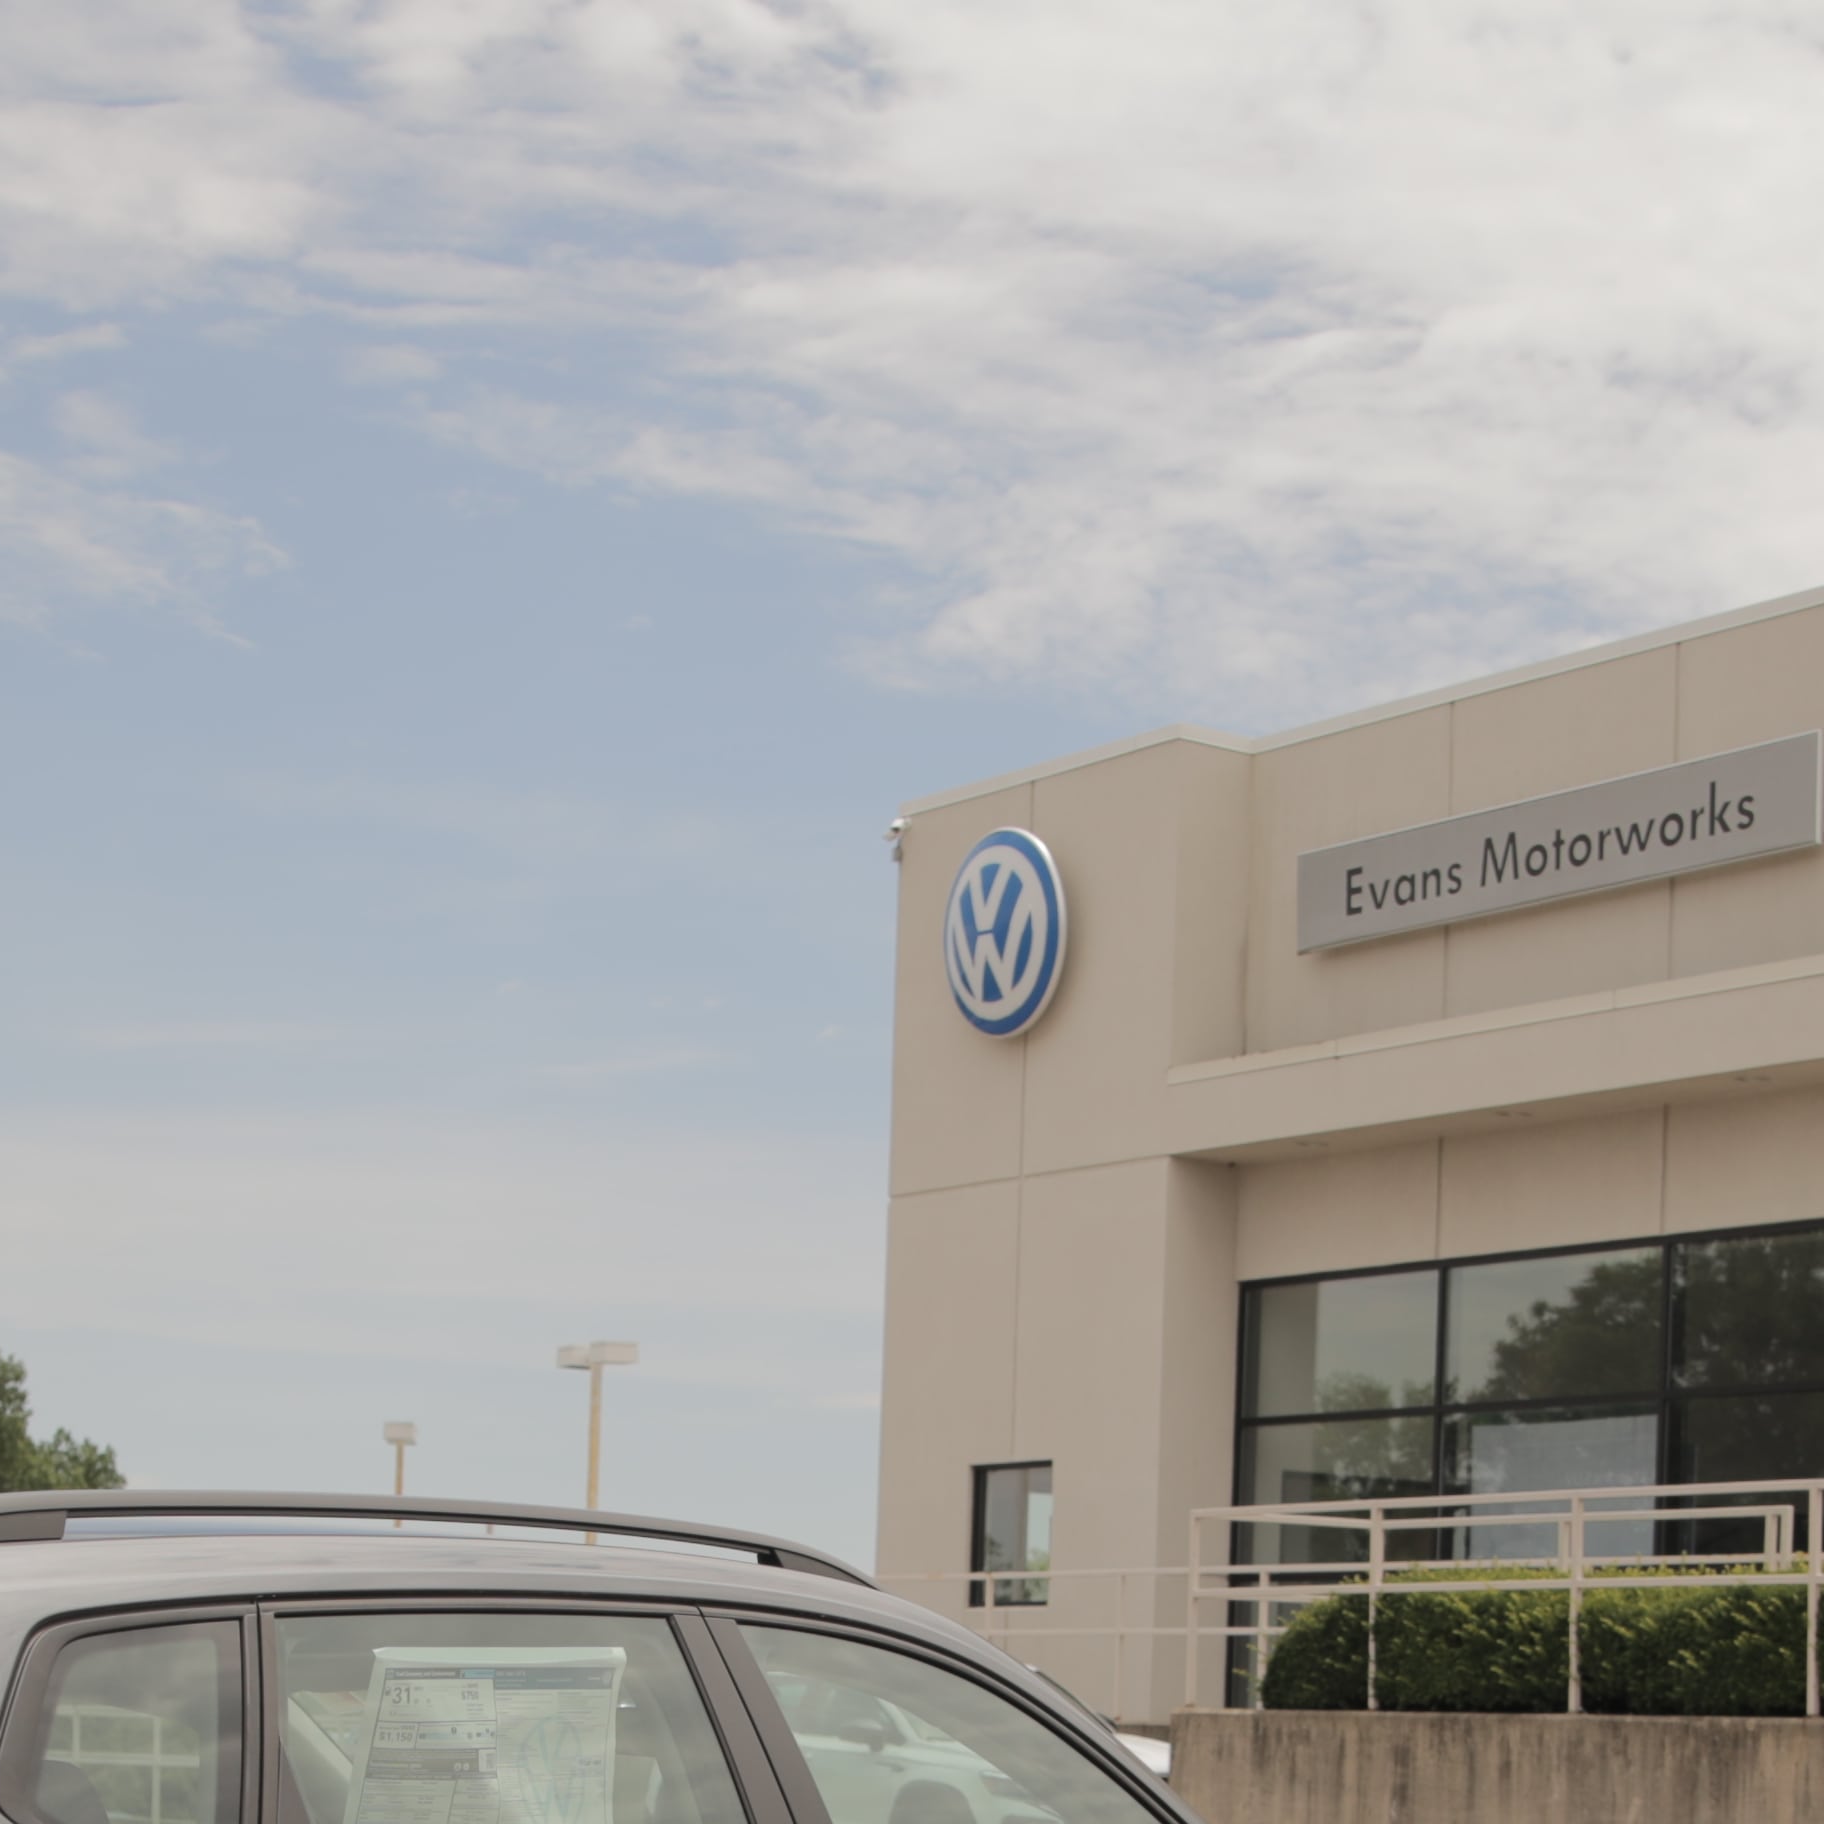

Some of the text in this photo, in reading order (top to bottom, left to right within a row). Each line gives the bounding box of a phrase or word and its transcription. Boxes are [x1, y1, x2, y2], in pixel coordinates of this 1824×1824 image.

[1344, 781, 1756, 917] Evans Motorworks
[946, 836, 1056, 1028] VW
